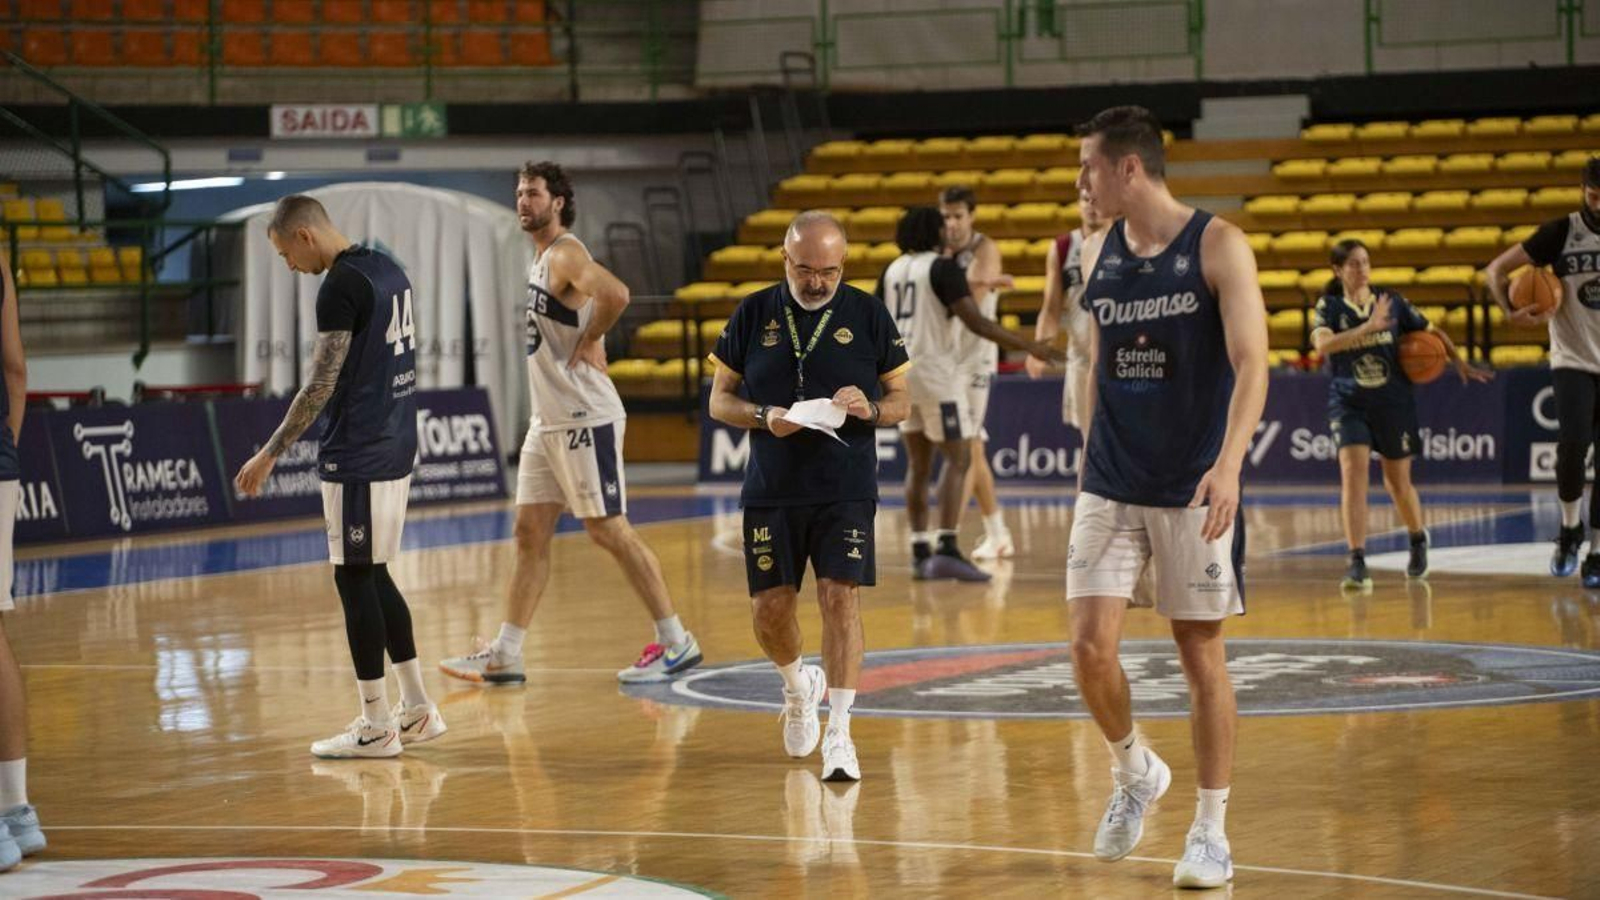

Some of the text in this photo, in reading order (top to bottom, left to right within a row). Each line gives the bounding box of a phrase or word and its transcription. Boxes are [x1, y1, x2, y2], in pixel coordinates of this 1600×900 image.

[282, 108, 370, 132] SAIDA
[894, 281, 916, 320] 10
[1092, 291, 1199, 326] Ourense
[386, 289, 415, 356] 44
[1116, 347, 1166, 363] Estrella
[1116, 363, 1163, 378] Galicia
[567, 427, 593, 450] 24
[992, 432, 1082, 477] clou
[1418, 427, 1496, 461] ision
[16, 481, 59, 520] RIA
[754, 527, 771, 542] ML
